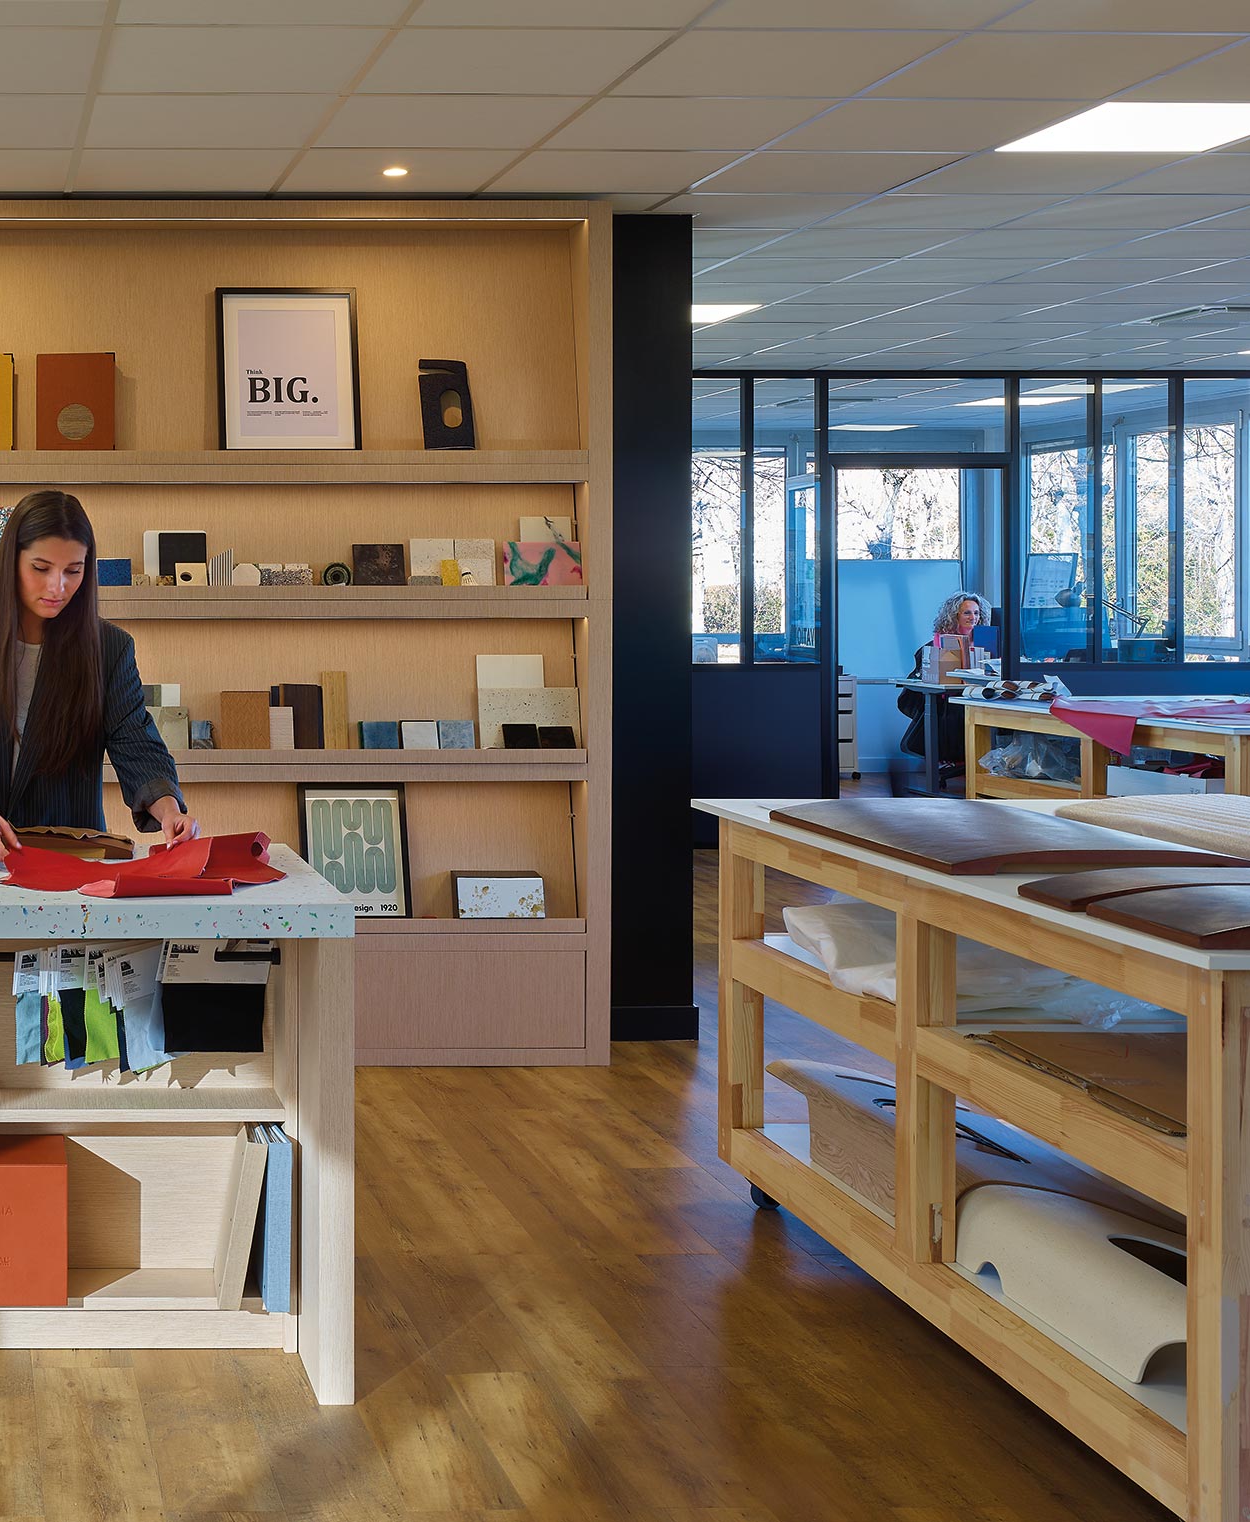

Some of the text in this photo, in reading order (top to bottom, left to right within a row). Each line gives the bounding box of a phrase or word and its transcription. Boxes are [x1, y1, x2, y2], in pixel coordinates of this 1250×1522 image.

[248, 377, 319, 403] BIG.
[354, 904, 398, 913] esign 1920
